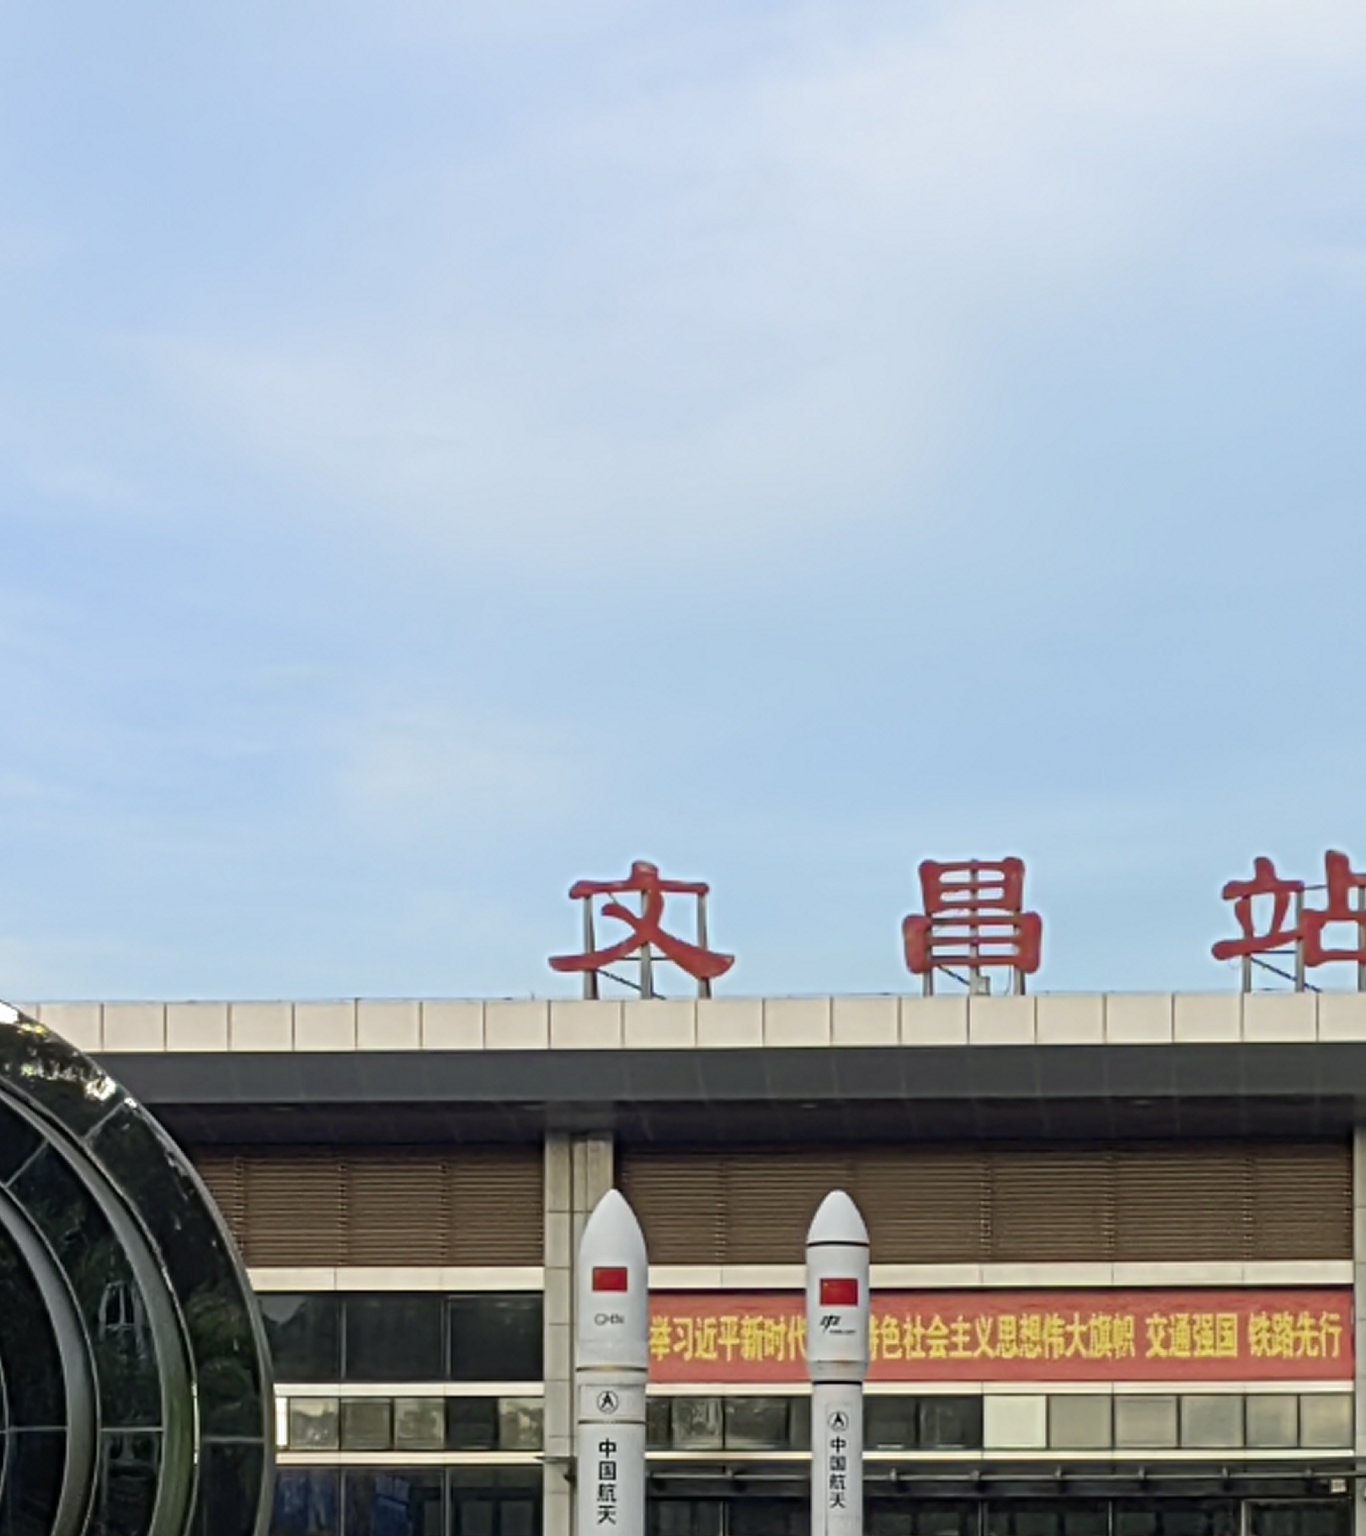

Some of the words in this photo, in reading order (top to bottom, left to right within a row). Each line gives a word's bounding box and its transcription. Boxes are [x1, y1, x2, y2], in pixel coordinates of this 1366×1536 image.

[1145, 1312, 1238, 1358] 交通强国
[1247, 1311, 1343, 1358] 铁路先行
[597, 1437, 617, 1525] 中国航天
[829, 1435, 847, 1509] 中国航天
